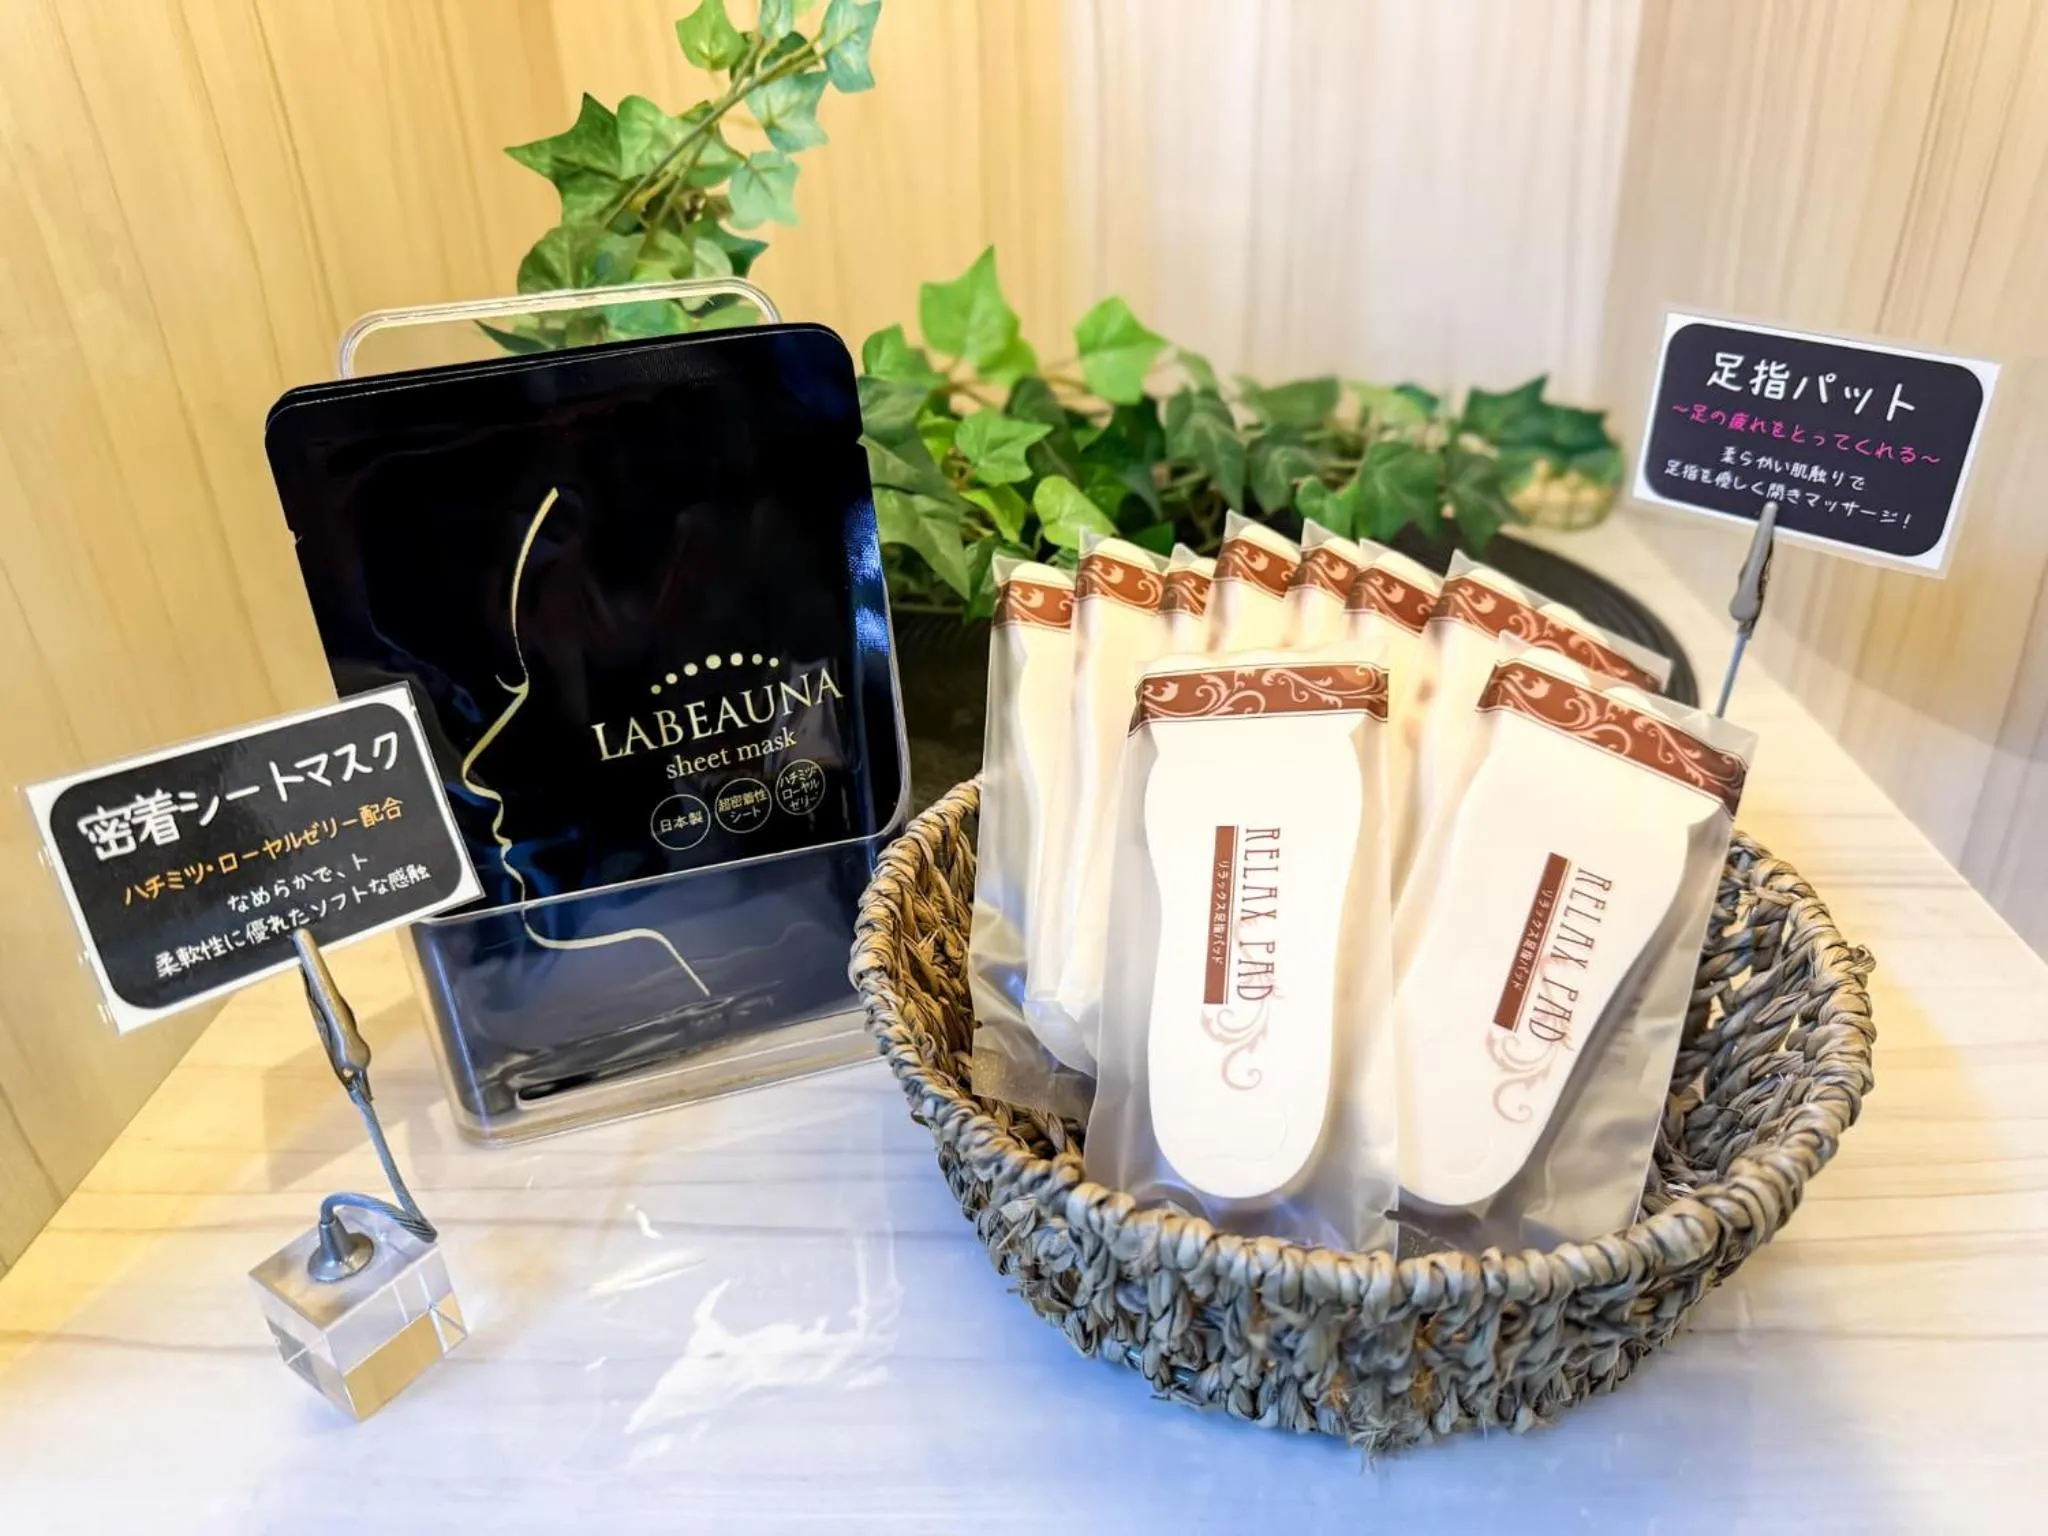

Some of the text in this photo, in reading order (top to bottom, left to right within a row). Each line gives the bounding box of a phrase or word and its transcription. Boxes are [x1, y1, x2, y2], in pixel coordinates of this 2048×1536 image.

[1706, 352, 1915, 421] 足指パット
[1720, 446, 1865, 491] 柔らかい肌触りで
[591, 667, 844, 761] LABEAUNA
[666, 727, 797, 780] sheet mask
[77, 731, 398, 861] 密着シートマスク
[660, 810, 704, 832] 日本製
[718, 789, 768, 812] 超密着性
[730, 806, 761, 823] シート
[782, 778, 820, 801] ローヤル
[125, 796, 403, 906] ハチミツ・ローヤルゼリー配合
[154, 862, 432, 979] 柔軟性に優れたソフトな感触
[1211, 860, 1230, 965] リラックス足指パッド
[1237, 827, 1281, 1001] RELAX PAD
[1529, 867, 1613, 1042] RELAX PAD
